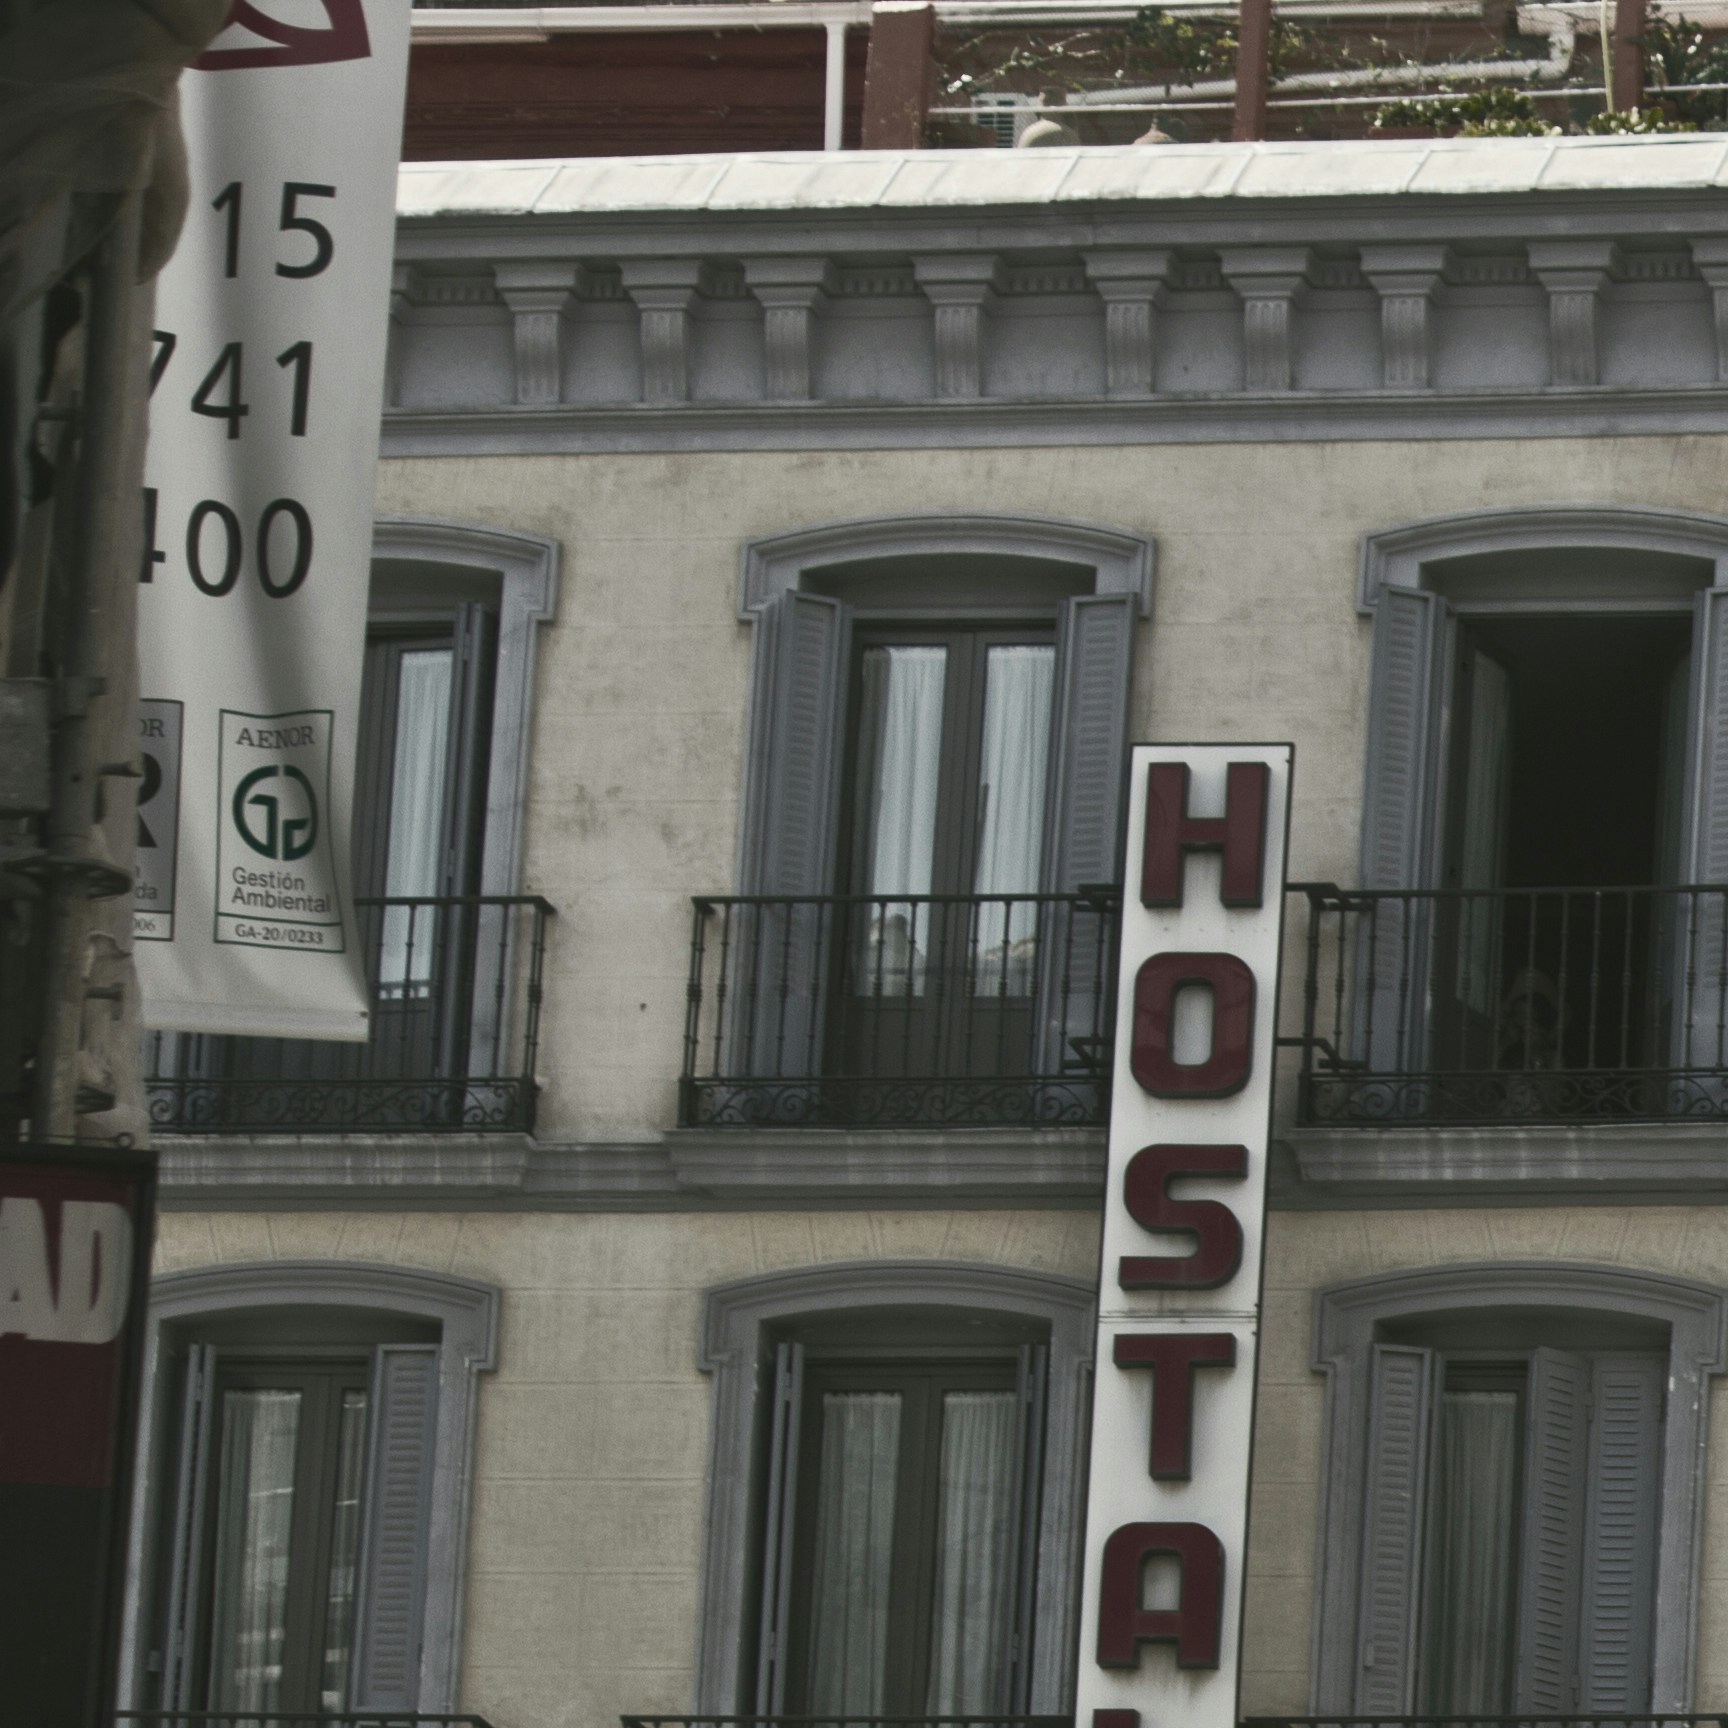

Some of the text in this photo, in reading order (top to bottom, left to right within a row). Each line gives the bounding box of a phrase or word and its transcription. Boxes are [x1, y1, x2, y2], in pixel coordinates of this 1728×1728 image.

[210, 180, 337, 280] 15
[235, 725, 315, 749] AENOR
[232, 866, 305, 891] Gestión
[231, 886, 332, 914] Ambiental
[234, 923, 324, 945] GA-20/0233
